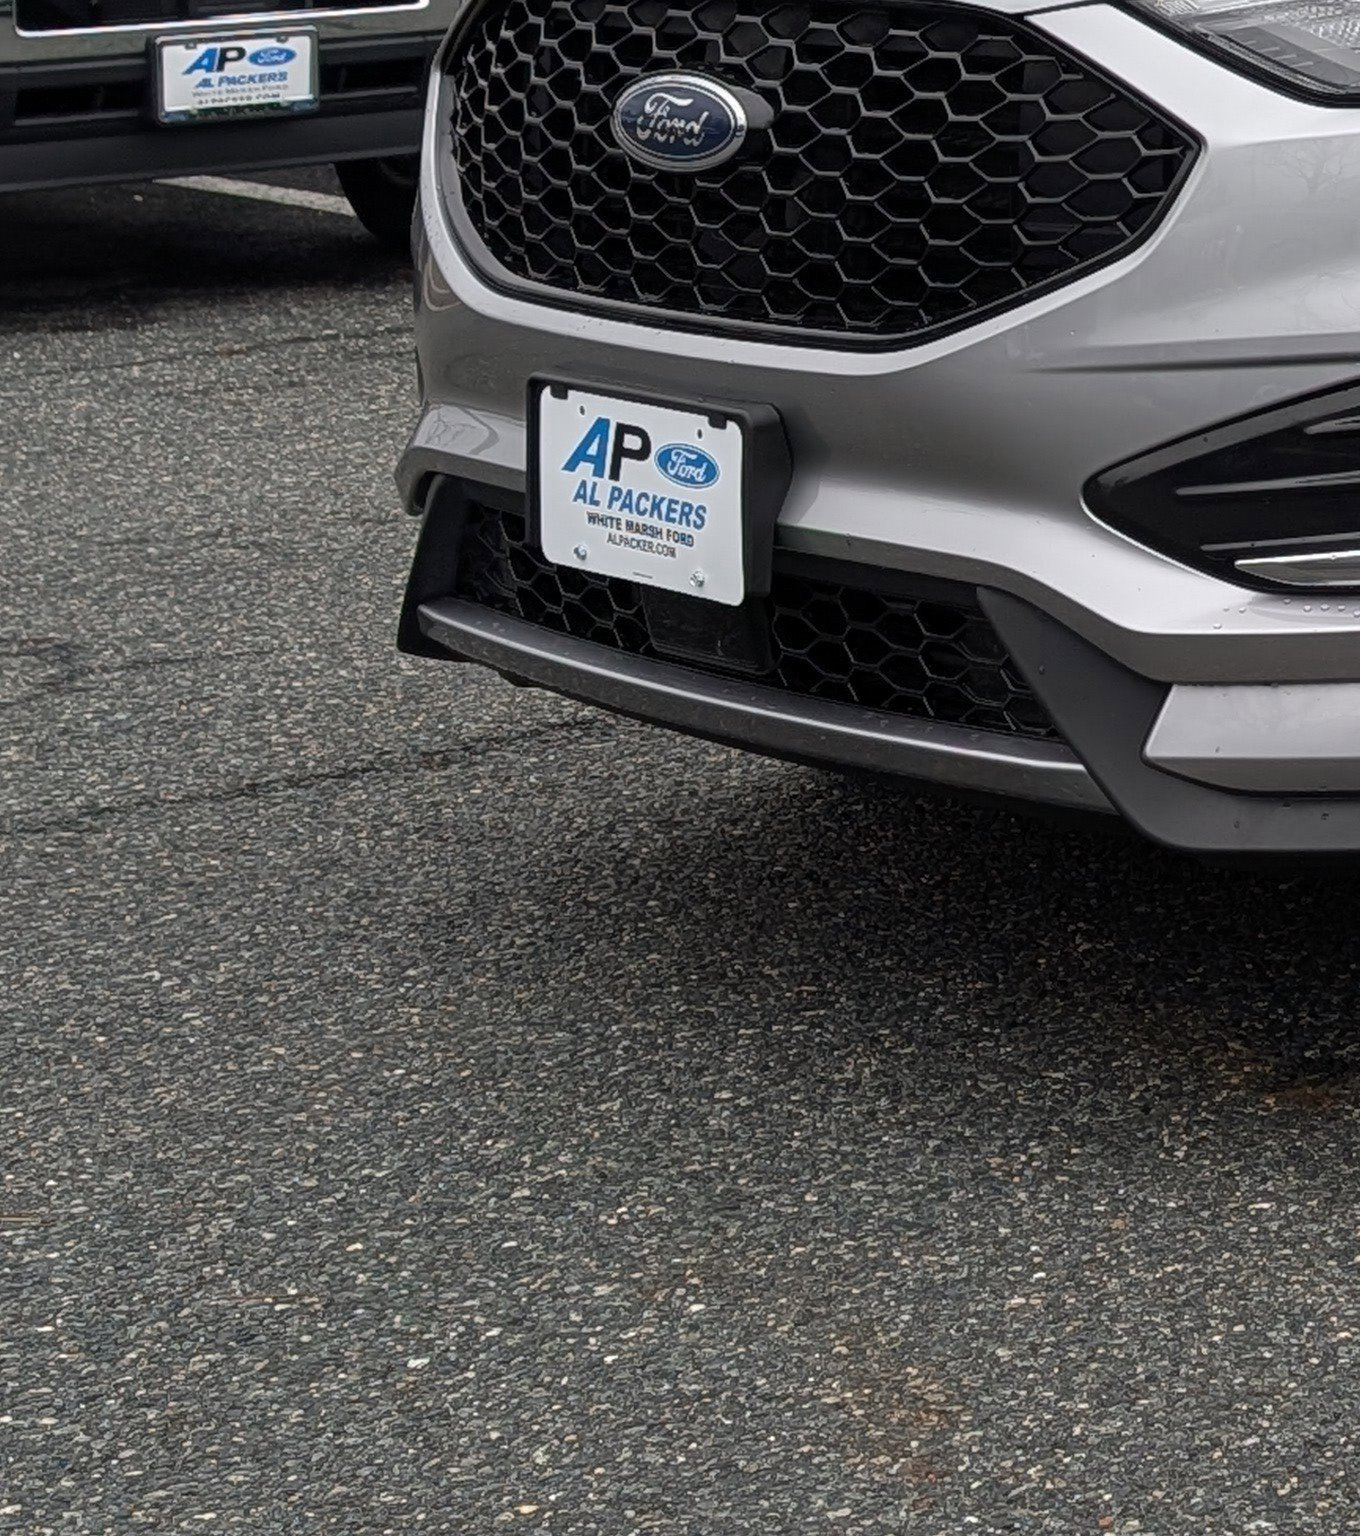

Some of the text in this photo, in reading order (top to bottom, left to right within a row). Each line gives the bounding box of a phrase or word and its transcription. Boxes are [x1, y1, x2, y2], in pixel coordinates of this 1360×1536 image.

[181, 46, 247, 76] AP
[635, 91, 710, 148] Ford
[561, 415, 709, 482] AP Ford
[572, 479, 708, 531] AL PACKERS
[586, 511, 695, 548] WHITE MARSH FORD
